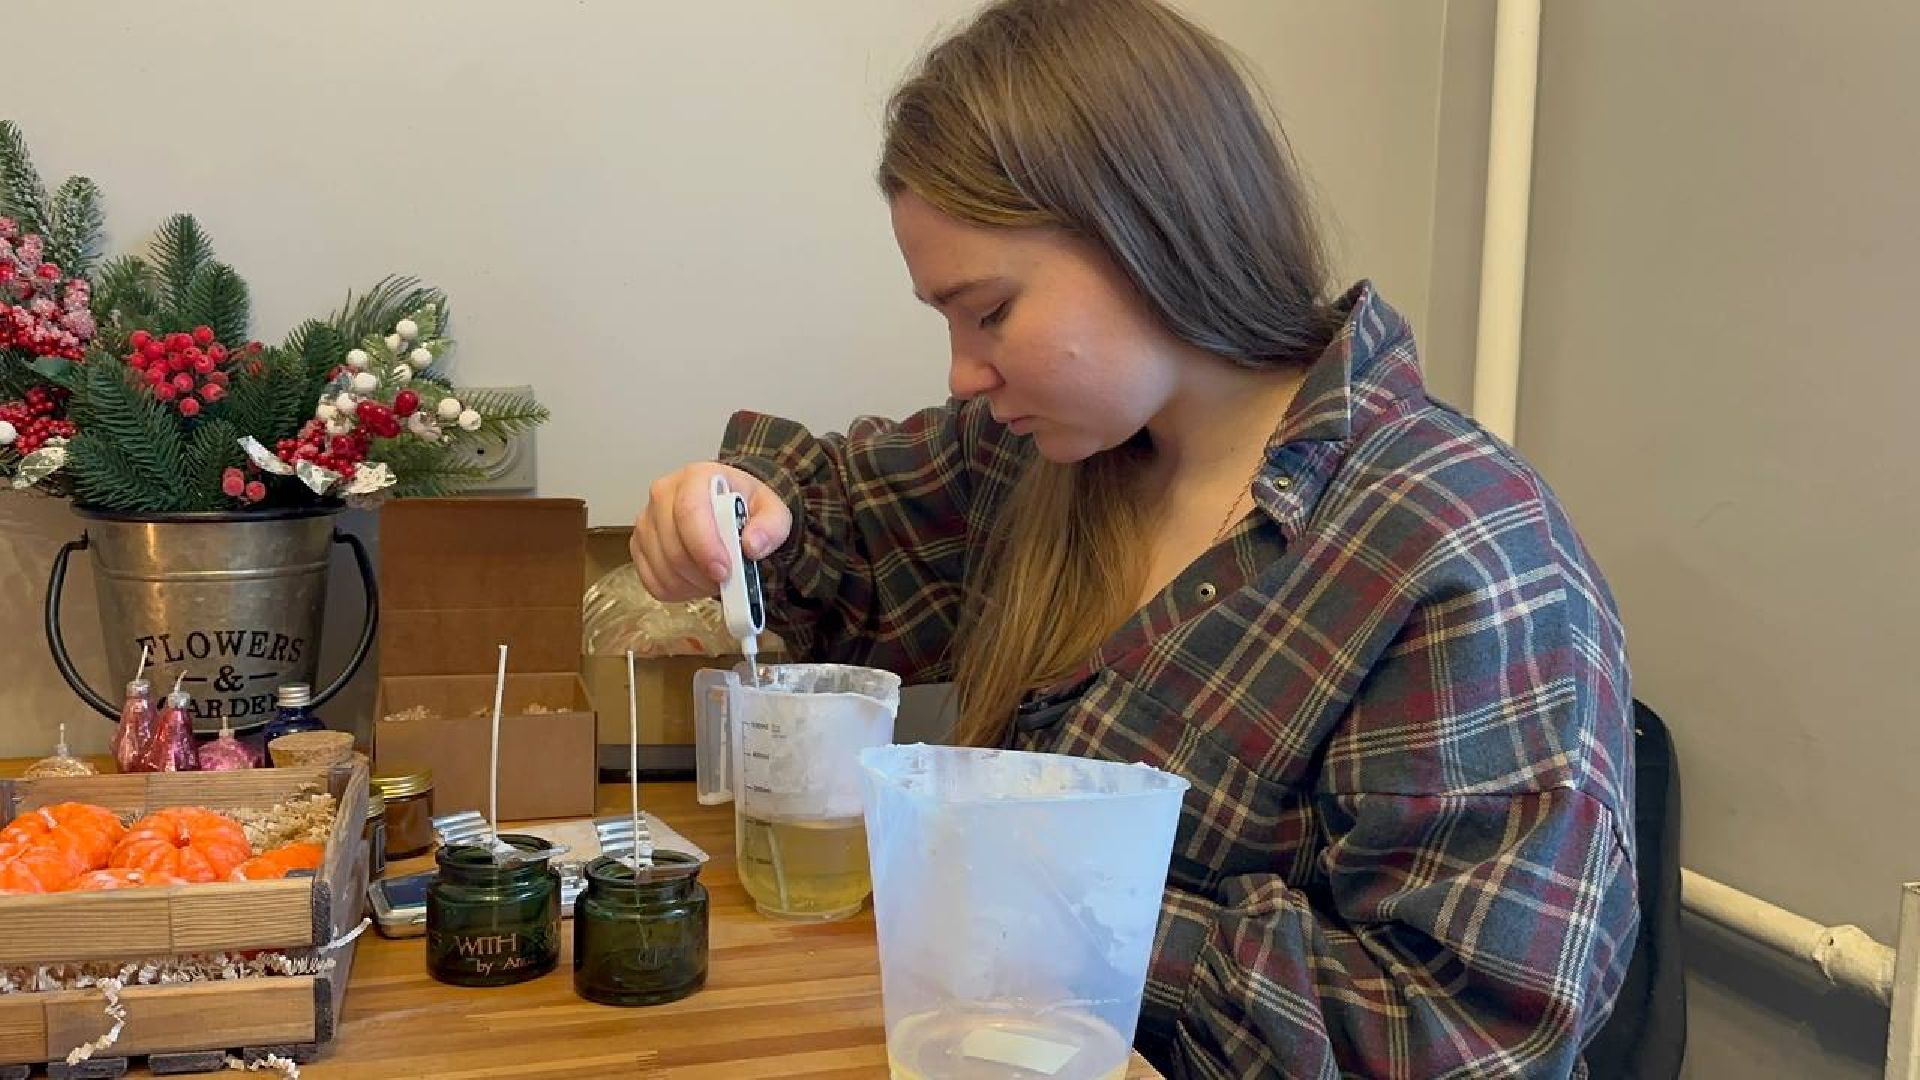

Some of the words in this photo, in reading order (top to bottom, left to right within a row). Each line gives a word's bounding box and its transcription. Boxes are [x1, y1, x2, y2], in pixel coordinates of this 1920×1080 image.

[135, 630, 304, 667] FLOWERS
[213, 665, 244, 692] &
[156, 693, 279, 718] ARDEN
[453, 933, 517, 955] WITH
[476, 959, 494, 977] by
